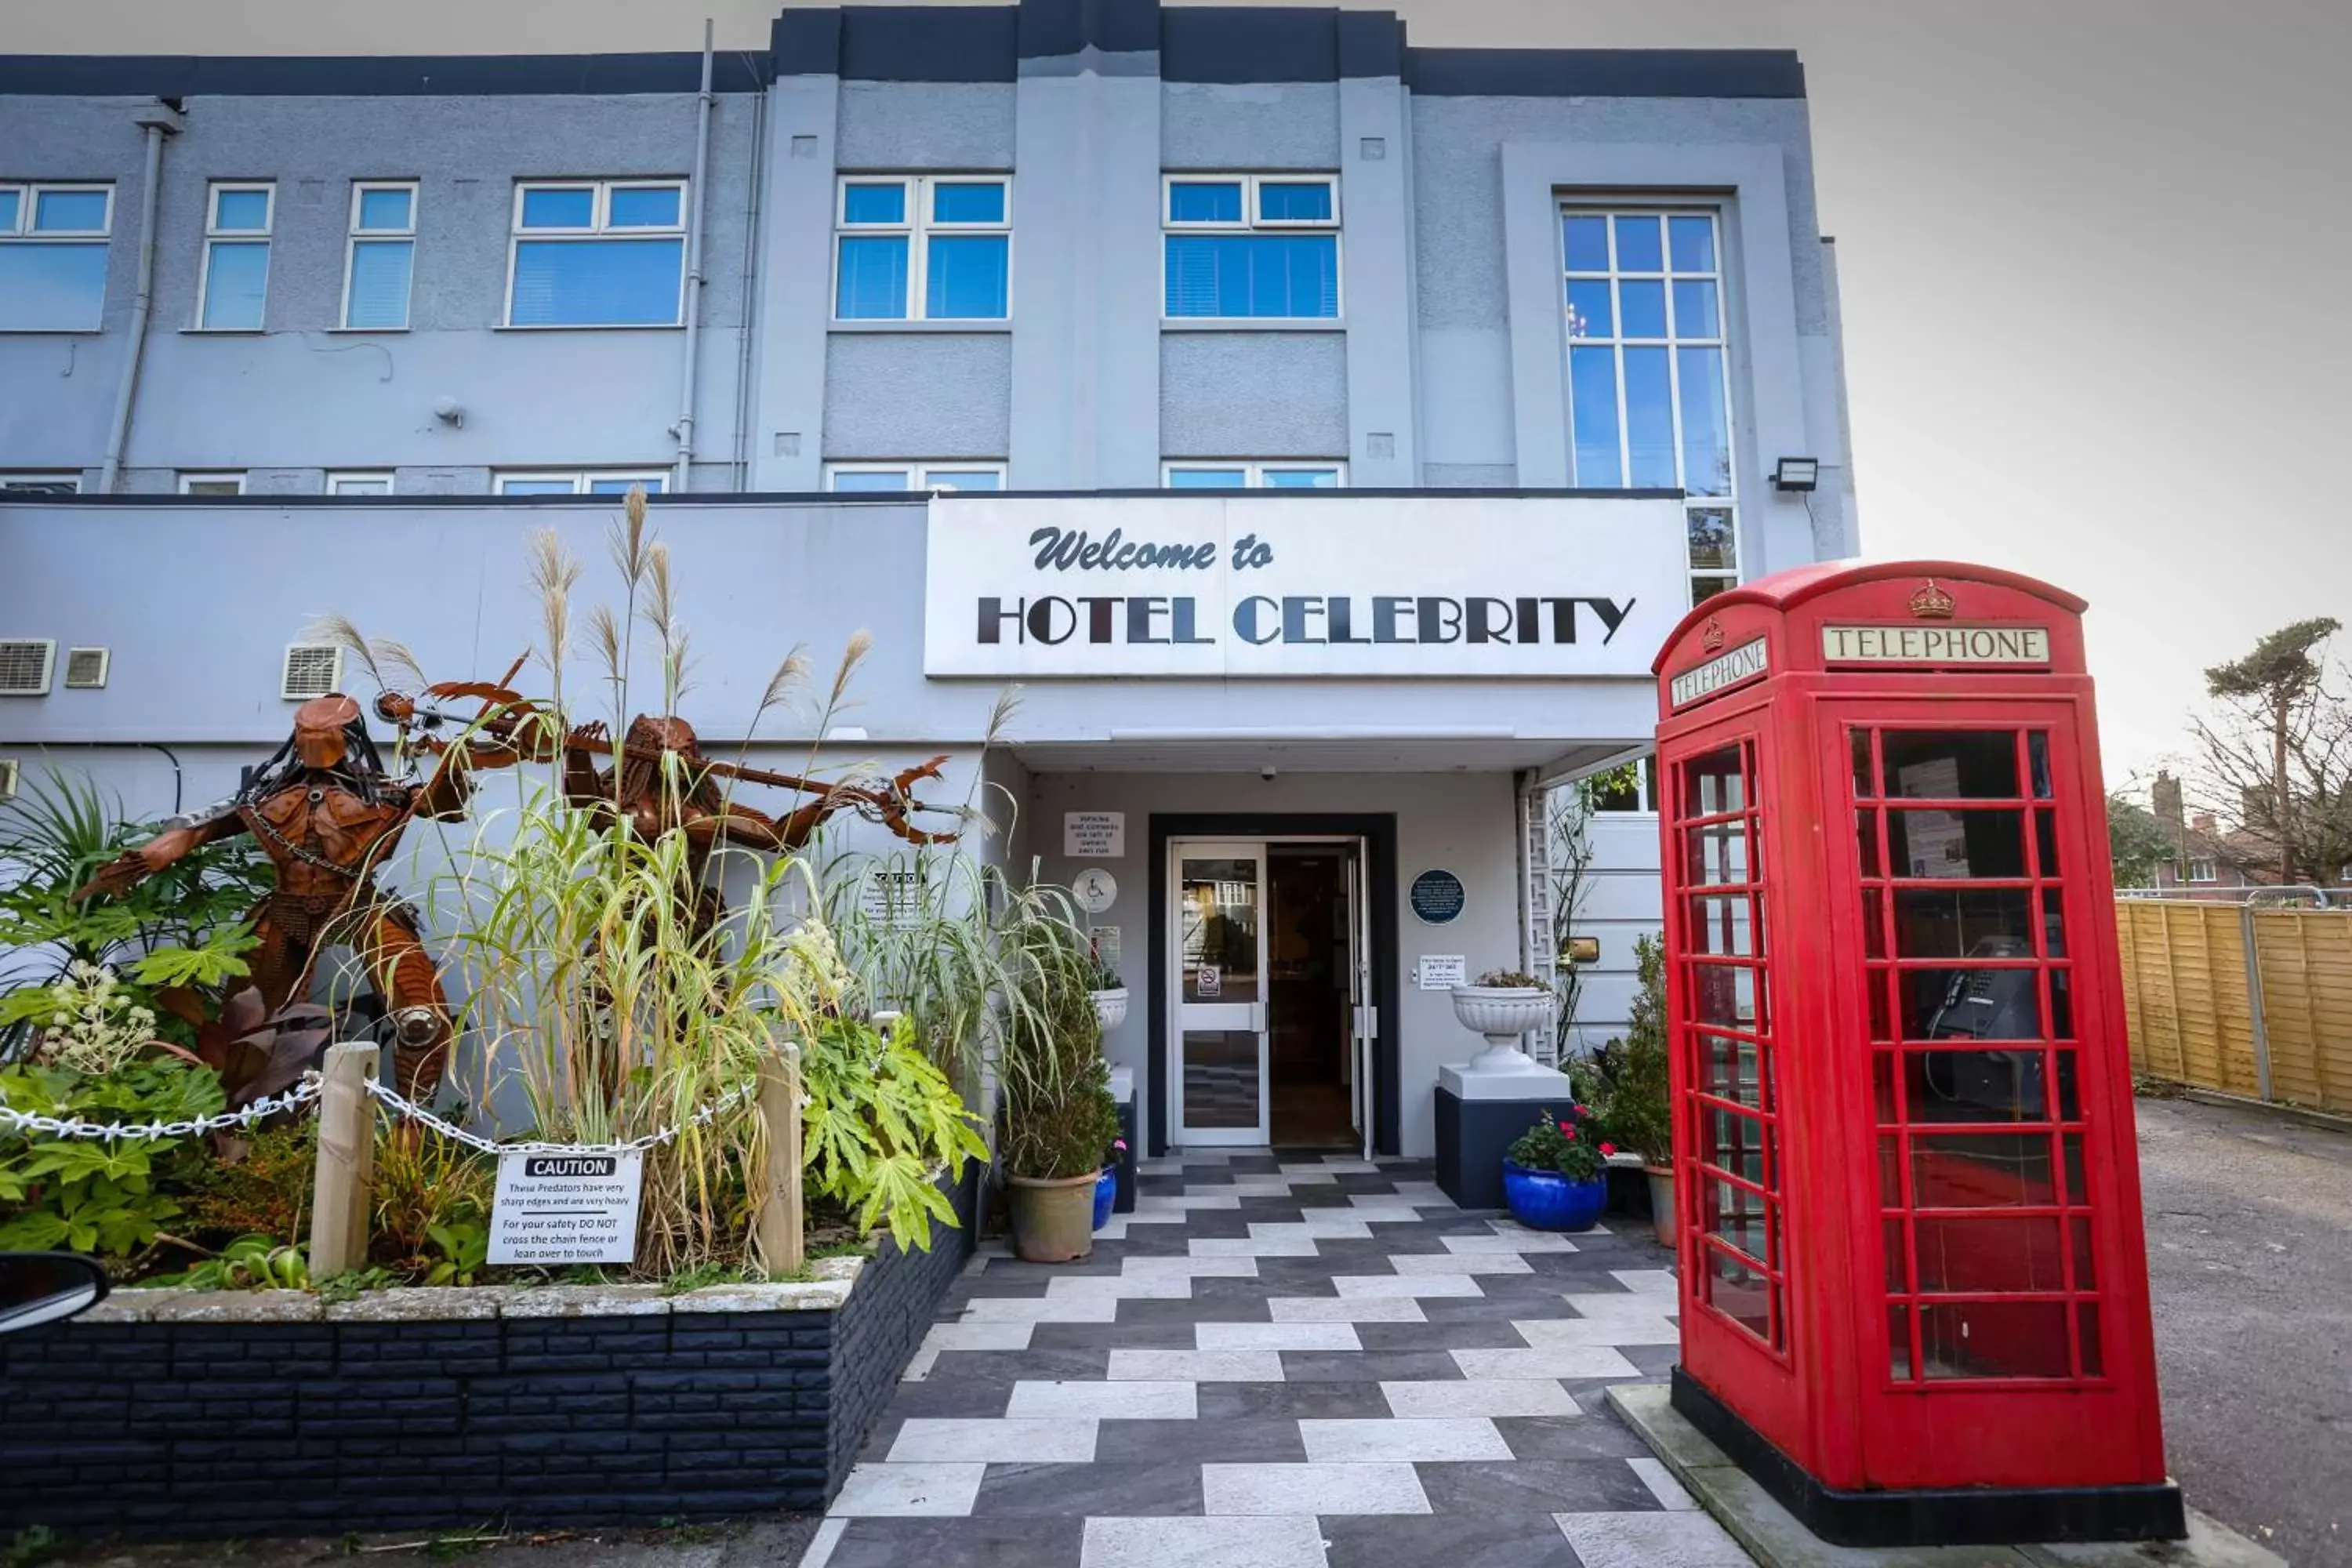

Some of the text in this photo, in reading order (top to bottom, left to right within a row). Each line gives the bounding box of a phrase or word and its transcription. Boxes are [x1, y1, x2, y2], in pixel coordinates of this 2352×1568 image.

[1029, 525, 1274, 572] Welcome to
[977, 595, 1637, 647] HOTEL CELEBRITY
[1831, 629, 2042, 659] TELEPHONE
[1673, 642, 1766, 704] TELEPHONE
[534, 1160, 607, 1174] CAUTION
[538, 1184, 581, 1192] Predators
[583, 1184, 604, 1192] have
[605, 1185, 624, 1194] very
[501, 1198, 524, 1207] sharp
[503, 1219, 618, 1231] For your safety DO NOT
[531, 1234, 548, 1244] the
[550, 1234, 576, 1244] chain
[579, 1234, 604, 1243] fence
[514, 1249, 535, 1258] lean
[564, 1250, 575, 1258] to
[576, 1249, 604, 1258] touch
